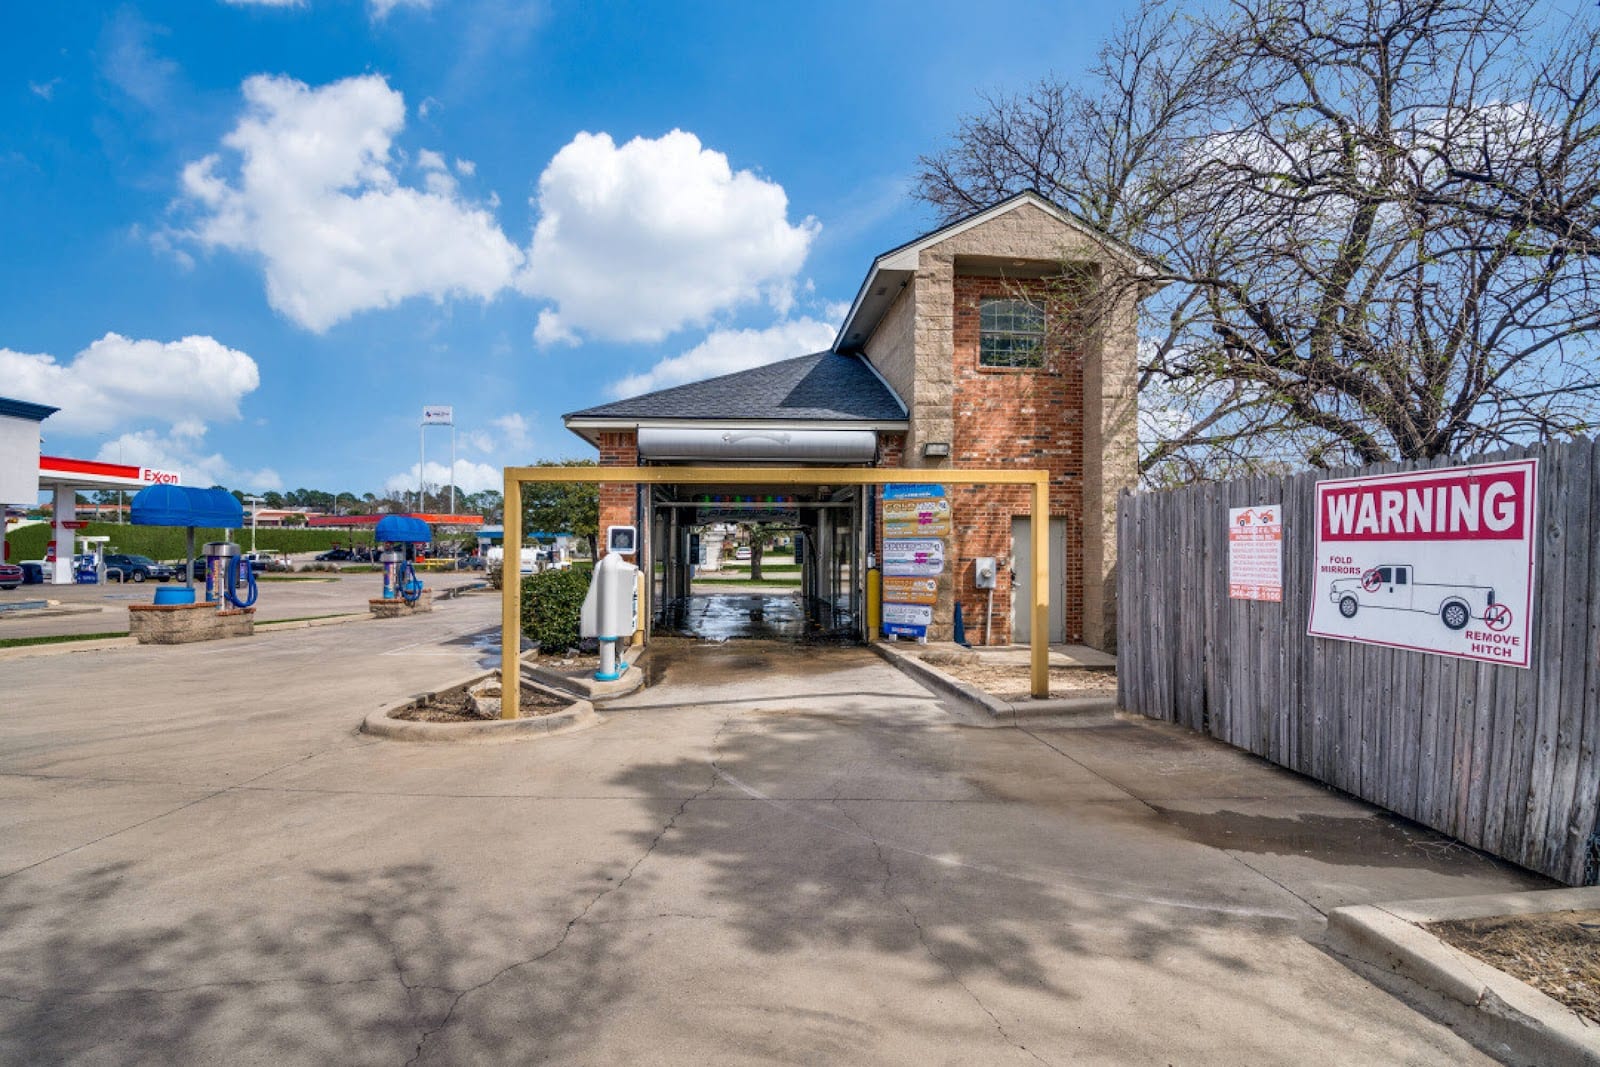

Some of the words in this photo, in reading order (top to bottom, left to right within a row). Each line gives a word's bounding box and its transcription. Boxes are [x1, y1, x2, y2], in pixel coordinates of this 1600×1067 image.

[144, 469, 178, 484] Exxon
[1327, 481, 1516, 534] WARNING
[1321, 565, 1361, 574] MIRRORS
[1465, 631, 1521, 646] REMOVE
[1471, 643, 1512, 657] HITCH
